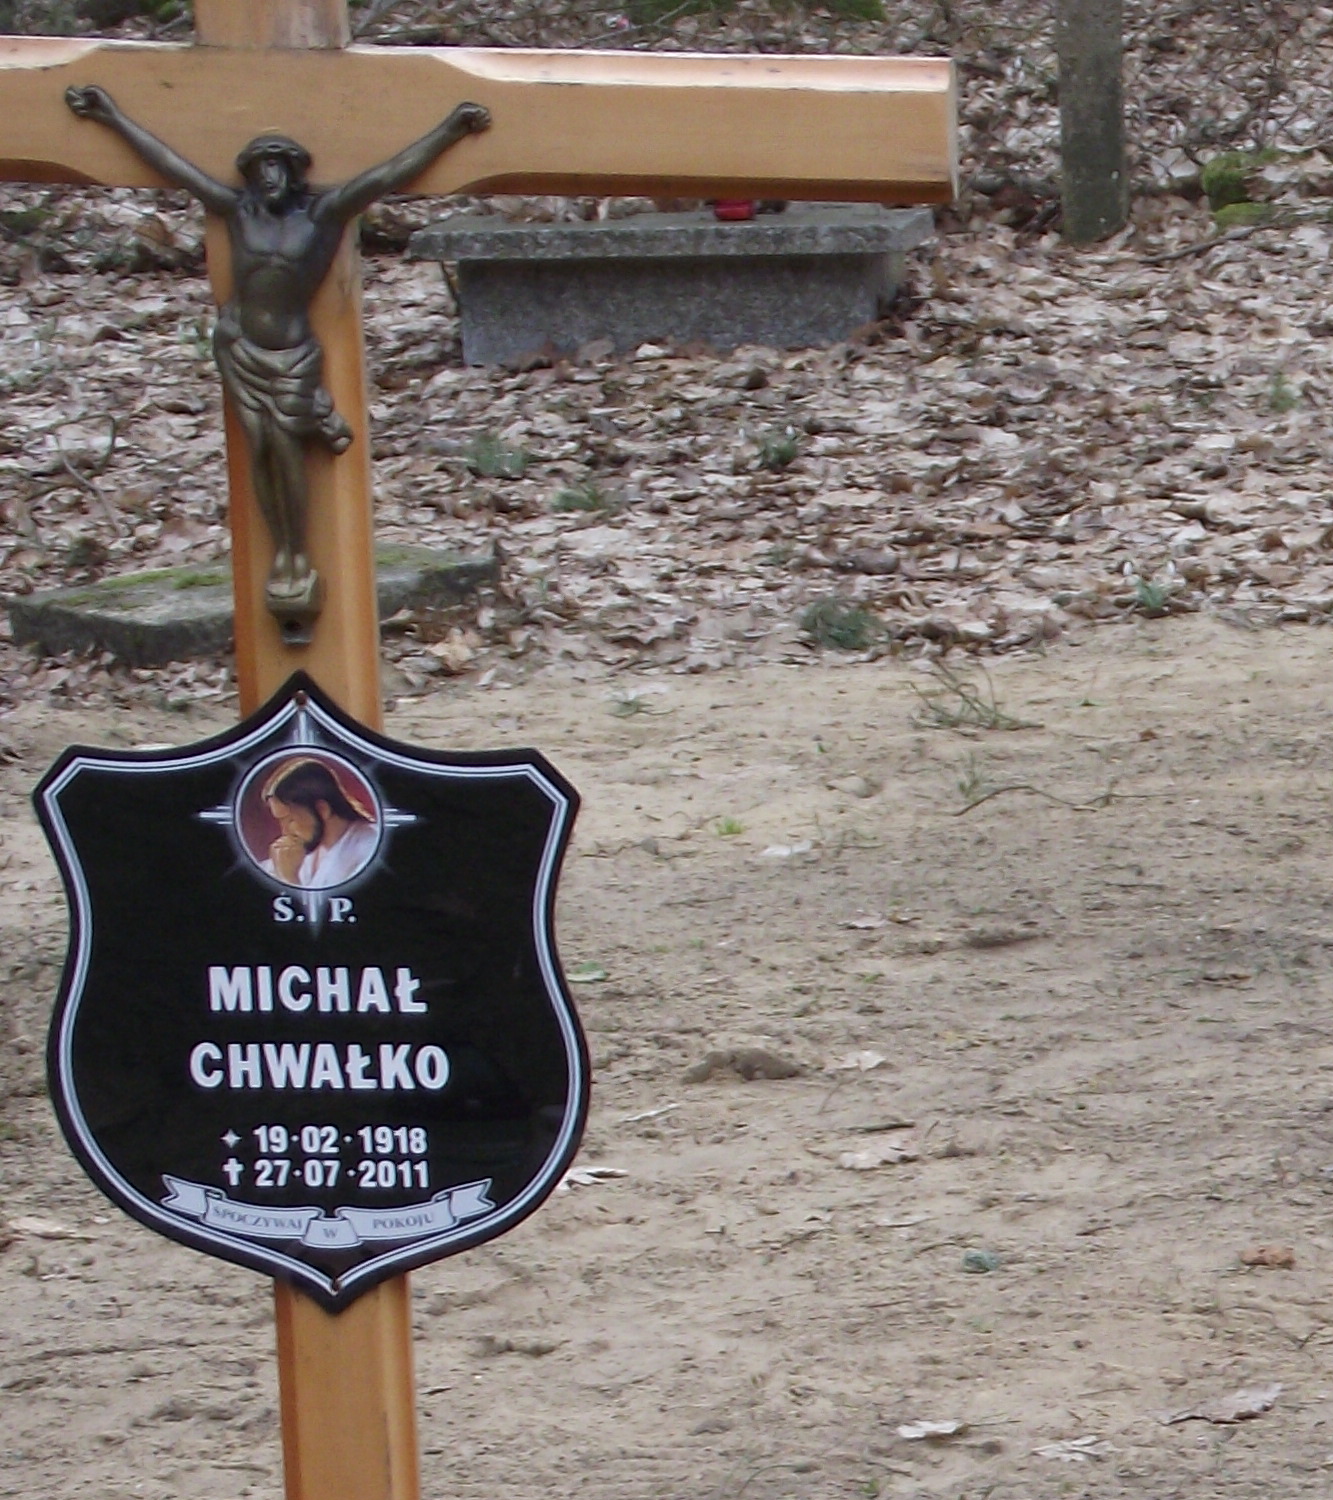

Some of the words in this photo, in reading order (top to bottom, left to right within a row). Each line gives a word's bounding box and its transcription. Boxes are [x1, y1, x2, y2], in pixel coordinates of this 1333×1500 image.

[328, 896, 358, 923] P.
[208, 965, 429, 1013] MICHAŁ
[189, 1042, 451, 1090] CHWAŁKO
[322, 1226, 339, 1240] W
[371, 1211, 437, 1230] POKOJU
